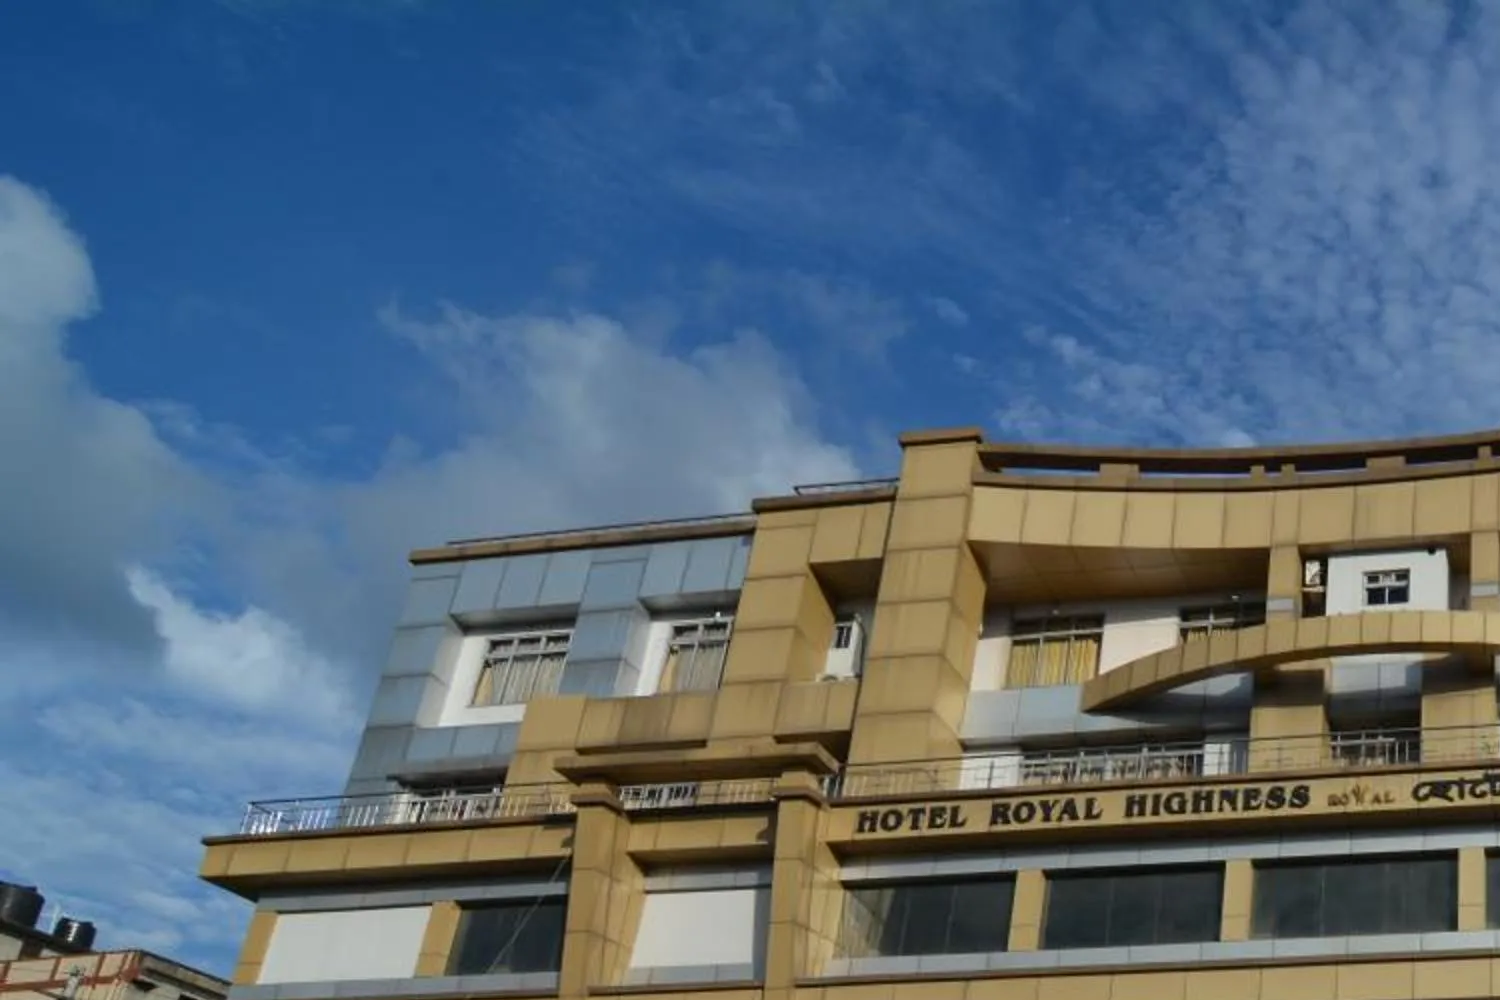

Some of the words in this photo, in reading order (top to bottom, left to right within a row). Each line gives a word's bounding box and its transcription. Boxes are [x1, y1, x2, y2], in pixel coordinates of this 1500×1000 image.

[856, 805, 967, 833] HOTEL
[989, 797, 1103, 826] ROYAL
[1123, 785, 1310, 817] HIGHNESS
